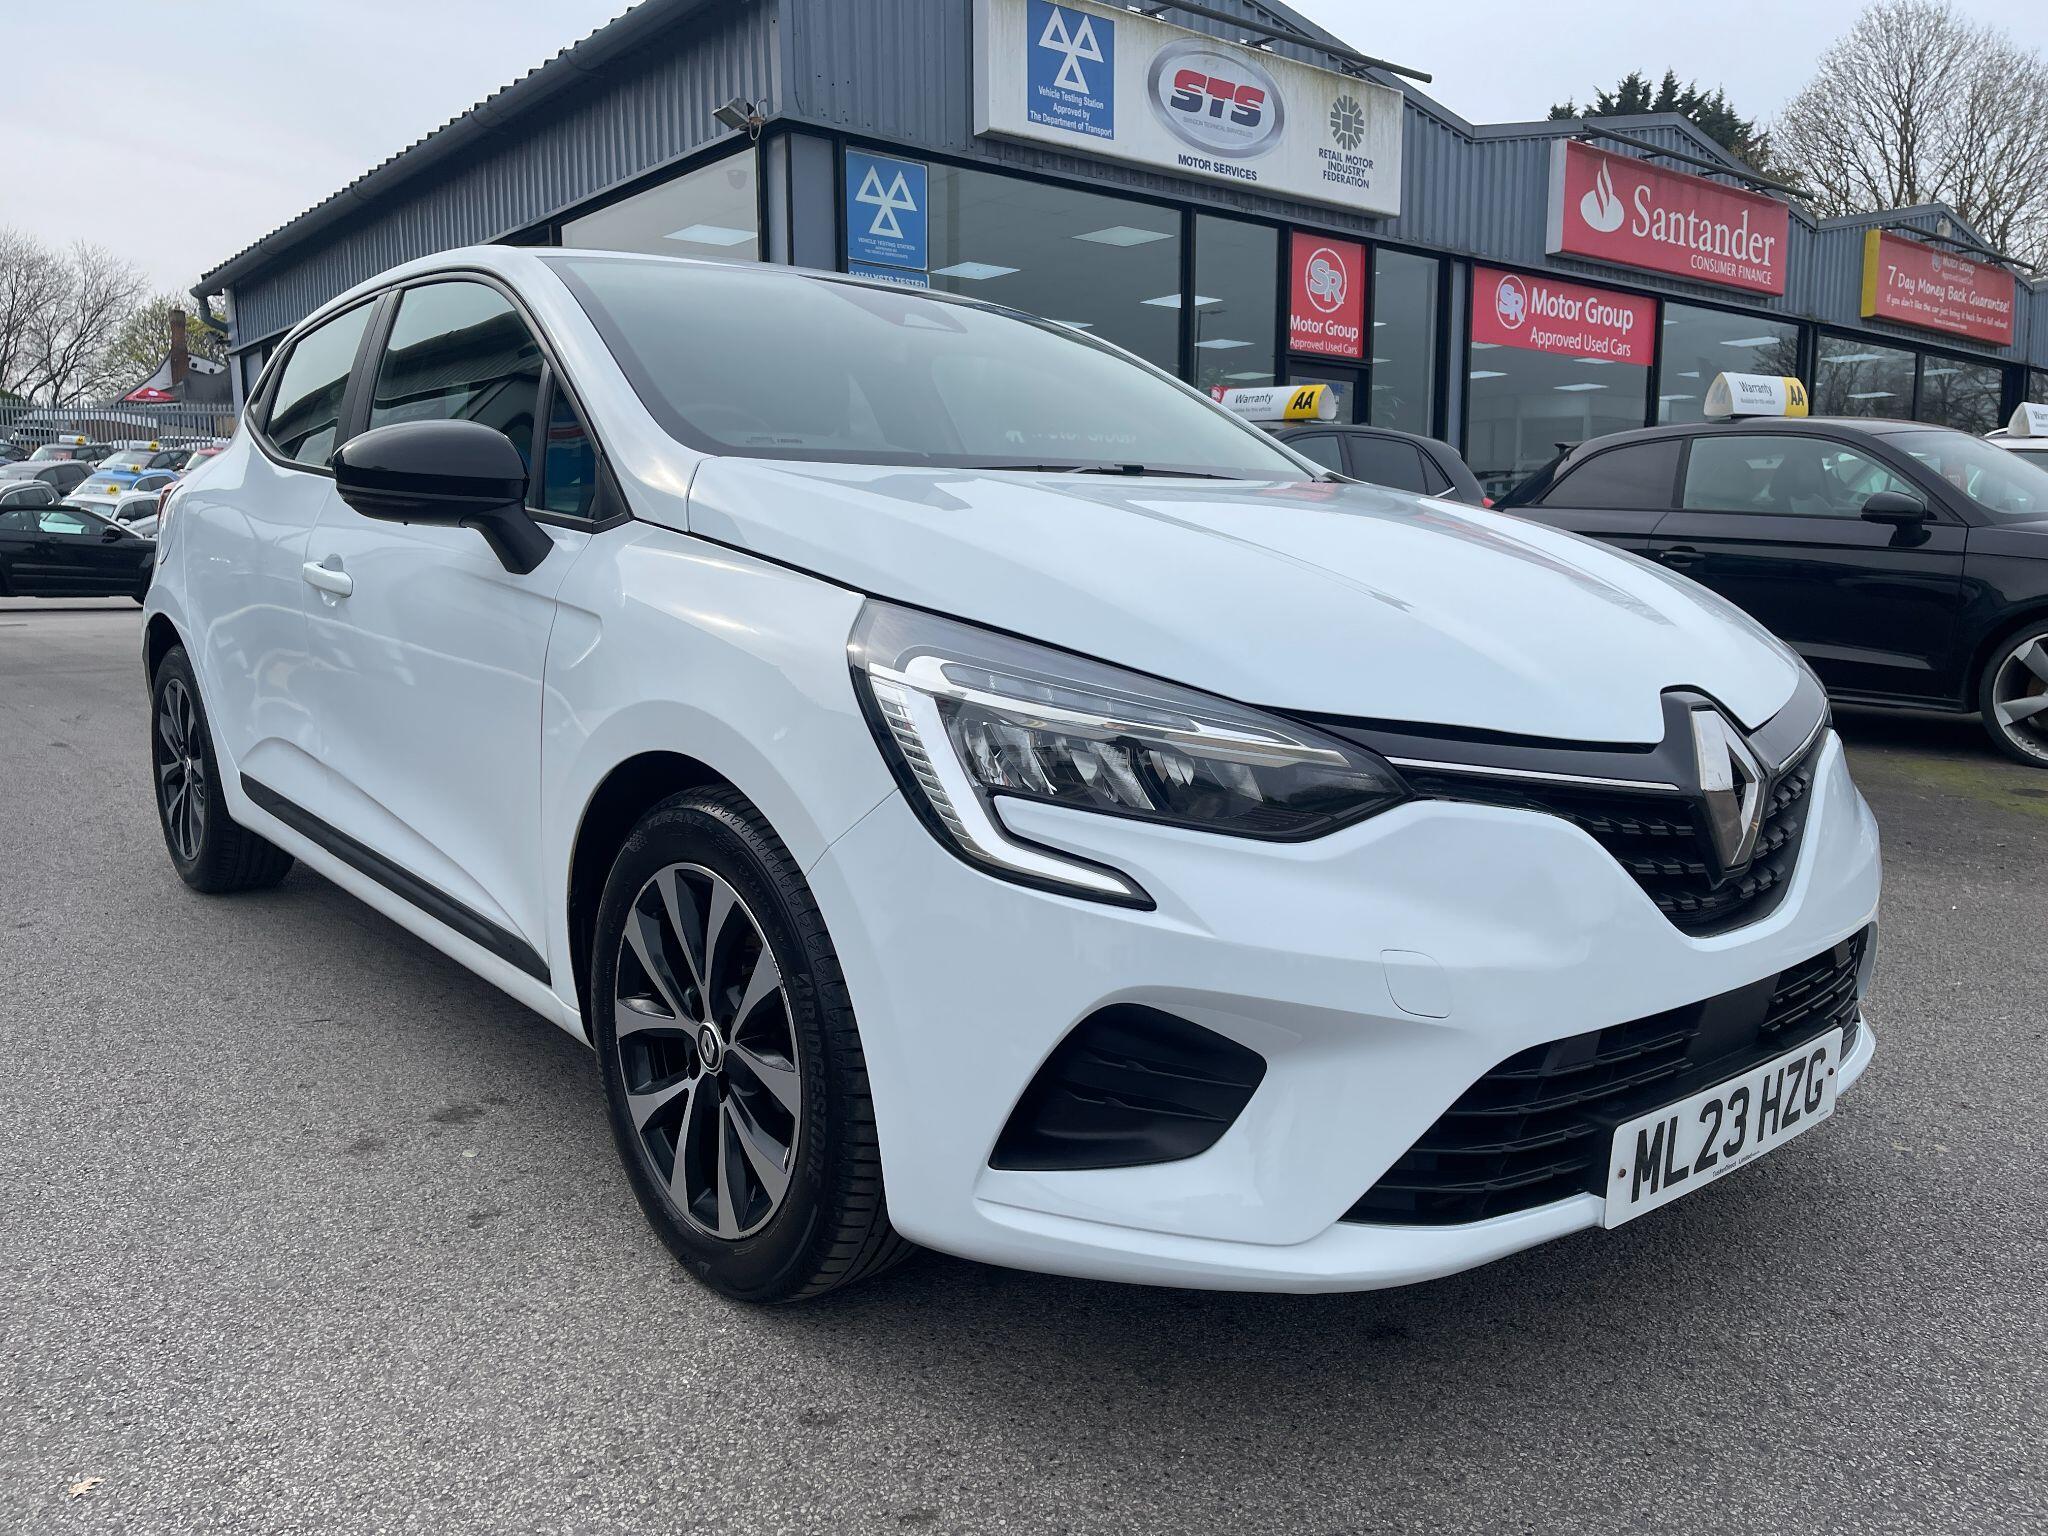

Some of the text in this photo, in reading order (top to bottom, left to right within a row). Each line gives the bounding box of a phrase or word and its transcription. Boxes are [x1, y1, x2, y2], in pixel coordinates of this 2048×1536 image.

[1038, 85, 1104, 109] Vehicle Testing Station
[1170, 68, 1265, 128] STS
[1030, 110, 1112, 137] The Department of Transport
[1053, 102, 1090, 121] Approved by
[1178, 154, 1257, 181] MOTOR SERVICES
[1319, 148, 1374, 169] RETAIL MOTOR
[1328, 160, 1365, 178] INDUSTRY
[1323, 170, 1369, 189] FEDERATION
[1632, 184, 1775, 267] Santander
[897, 243, 915, 251] STATION
[1309, 258, 1344, 305] SR
[1690, 254, 1772, 286] CONSUMER FINANCE
[1888, 265, 1897, 286] 7
[1898, 273, 1915, 295] Day
[1918, 279, 1945, 303] Money
[1948, 286, 1966, 304] Back
[1530, 287, 1634, 335] Motor Group
[1290, 314, 1359, 342] Motor Group
[1290, 336, 1358, 355] Approved Used Cars
[1530, 326, 1631, 357] Approved Used Cars
[1235, 393, 1273, 404] Warranty
[1292, 391, 1315, 410] AA
[1739, 380, 1772, 396] Warranty
[1790, 385, 1804, 406] AA
[1631, 1047, 1827, 1203] ML23 HZG
